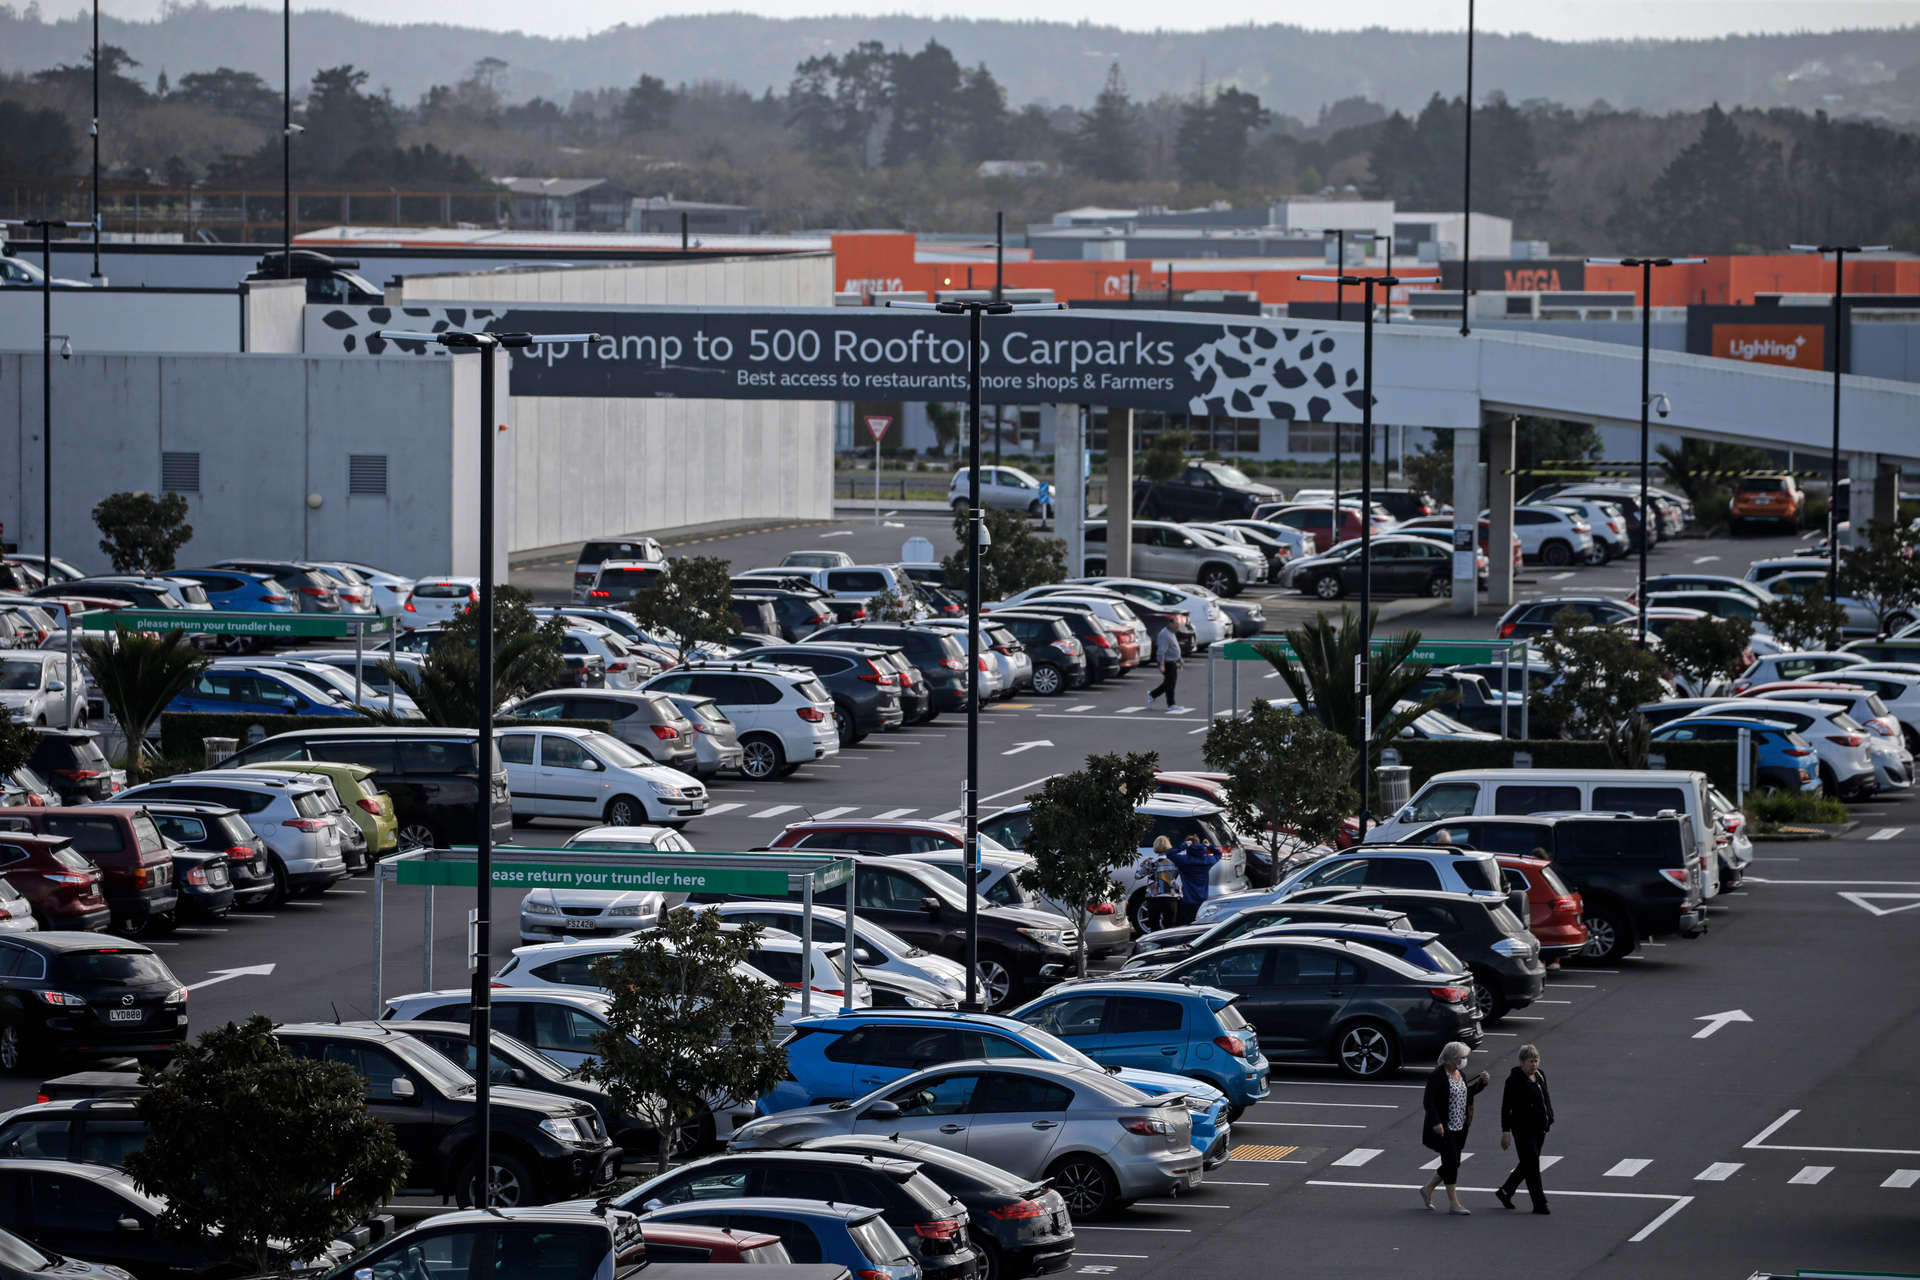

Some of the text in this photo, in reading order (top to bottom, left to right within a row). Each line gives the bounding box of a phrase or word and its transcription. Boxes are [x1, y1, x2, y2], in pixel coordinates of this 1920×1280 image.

[1504, 269, 1562, 291] MEGA
[582, 334, 683, 369] ramp
[693, 330, 733, 361] to
[749, 329, 821, 362] 500
[834, 329, 990, 372] Rooftop
[1002, 331, 1175, 373] Carparks
[737, 370, 1174, 393] Best access to restaurants, more shops & Farmers
[137, 618, 291, 632] please return your trundler here
[1412, 650, 1436, 660] here
[491, 871, 706, 886] ease return your trundler here
